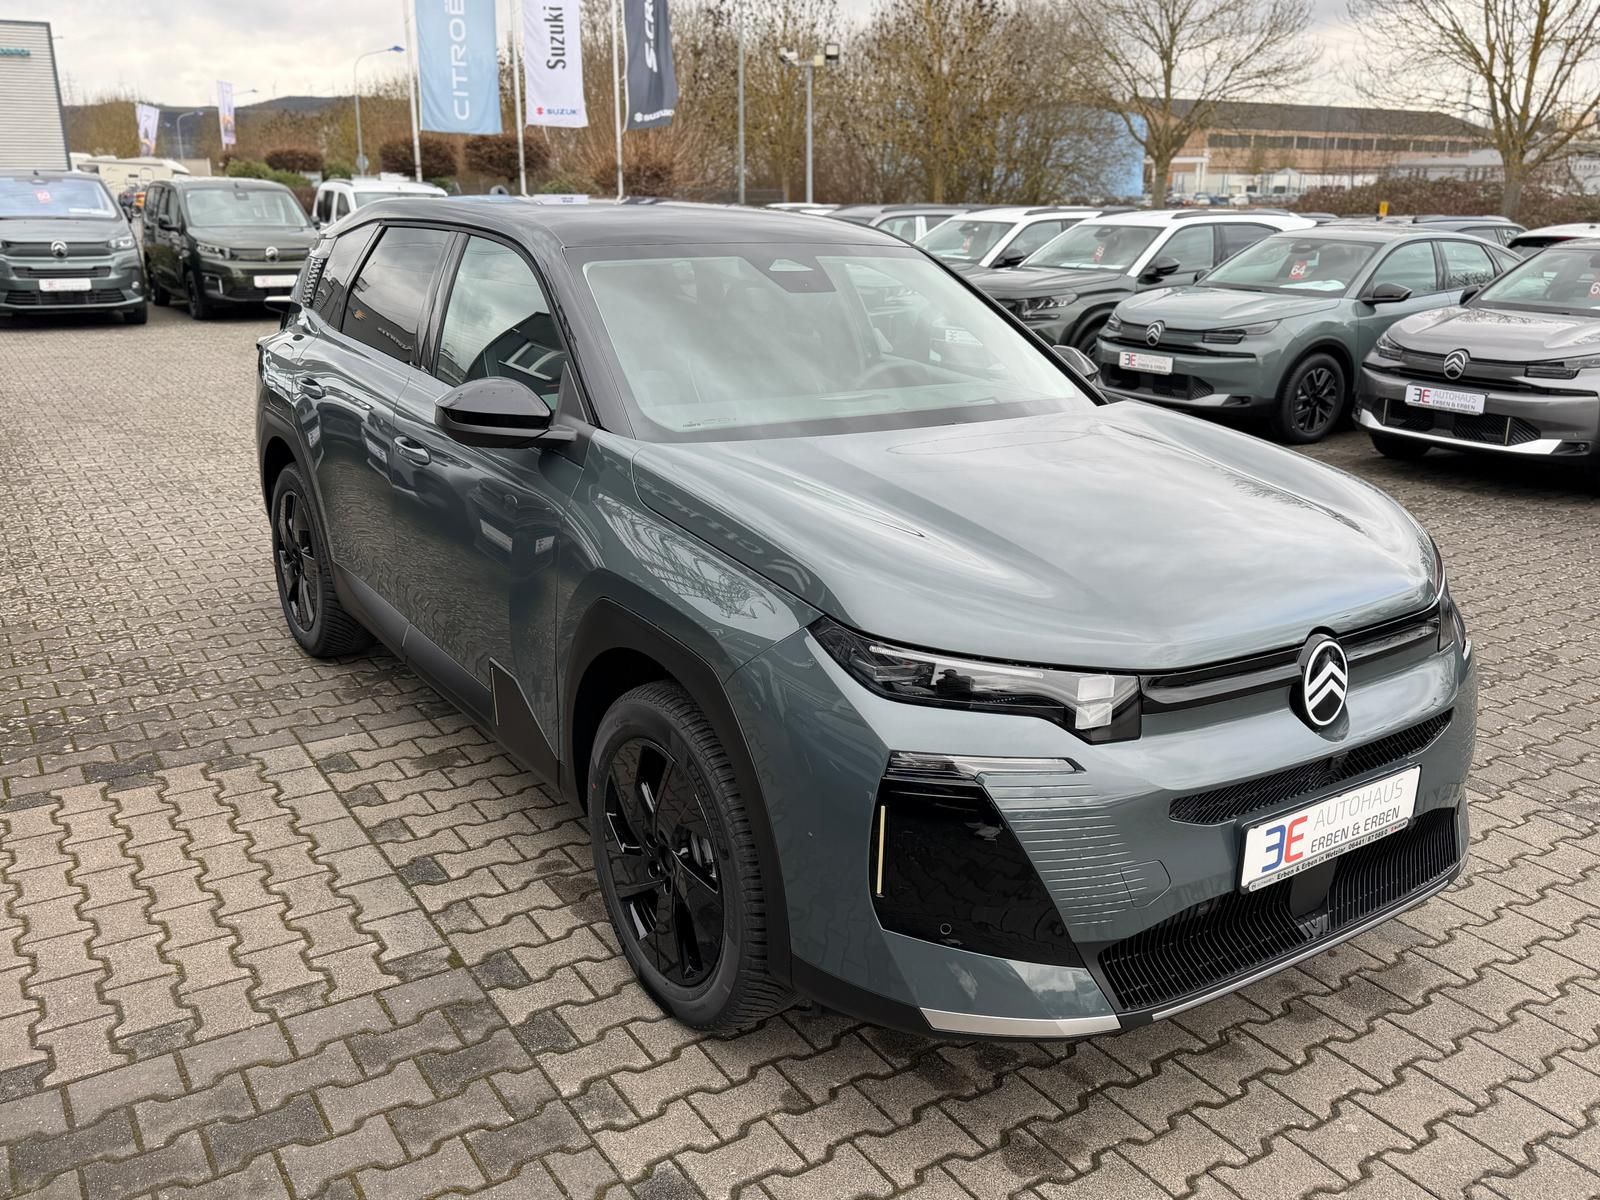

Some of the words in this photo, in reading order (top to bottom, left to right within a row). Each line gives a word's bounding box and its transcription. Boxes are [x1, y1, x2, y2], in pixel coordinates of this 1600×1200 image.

[543, 7, 566, 70] Suzuki
[1433, 390, 1477, 403] AUTOHAUS
[1310, 825, 1350, 854] ERBEN
[1351, 821, 1361, 837] &
[1363, 805, 1400, 832] ERBEN
[1313, 777, 1405, 832] AUTOHAUS
